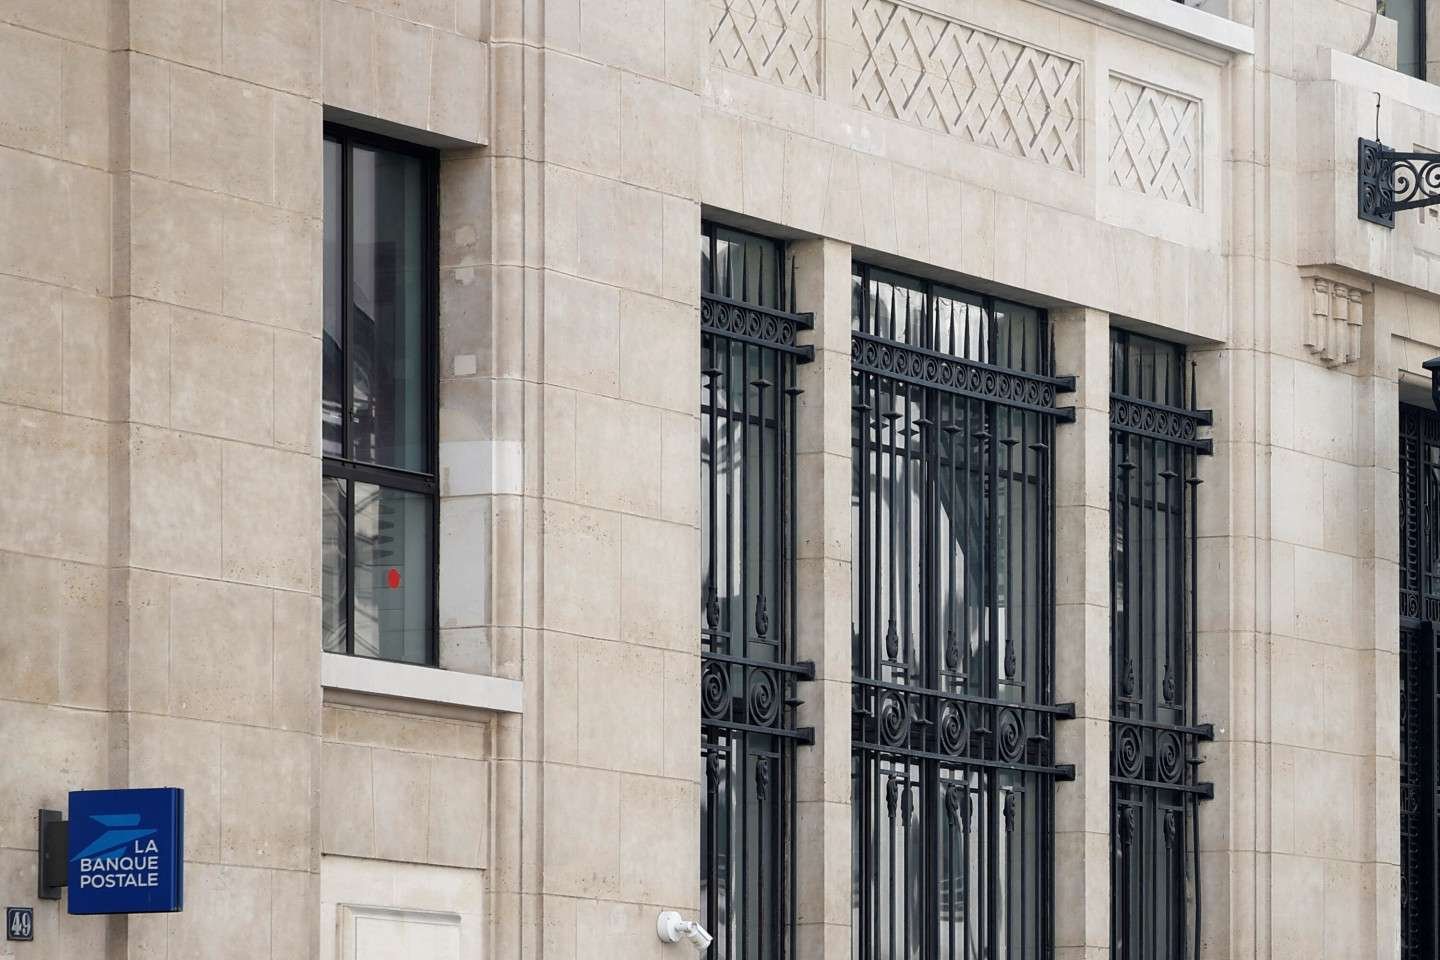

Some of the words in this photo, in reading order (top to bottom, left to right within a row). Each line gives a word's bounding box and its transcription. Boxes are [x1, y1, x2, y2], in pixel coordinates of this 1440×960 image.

[135, 839, 159, 854] LA
[80, 856, 159, 872] BANQUE
[80, 873, 159, 889] POSTALE
[11, 911, 32, 937] 49
